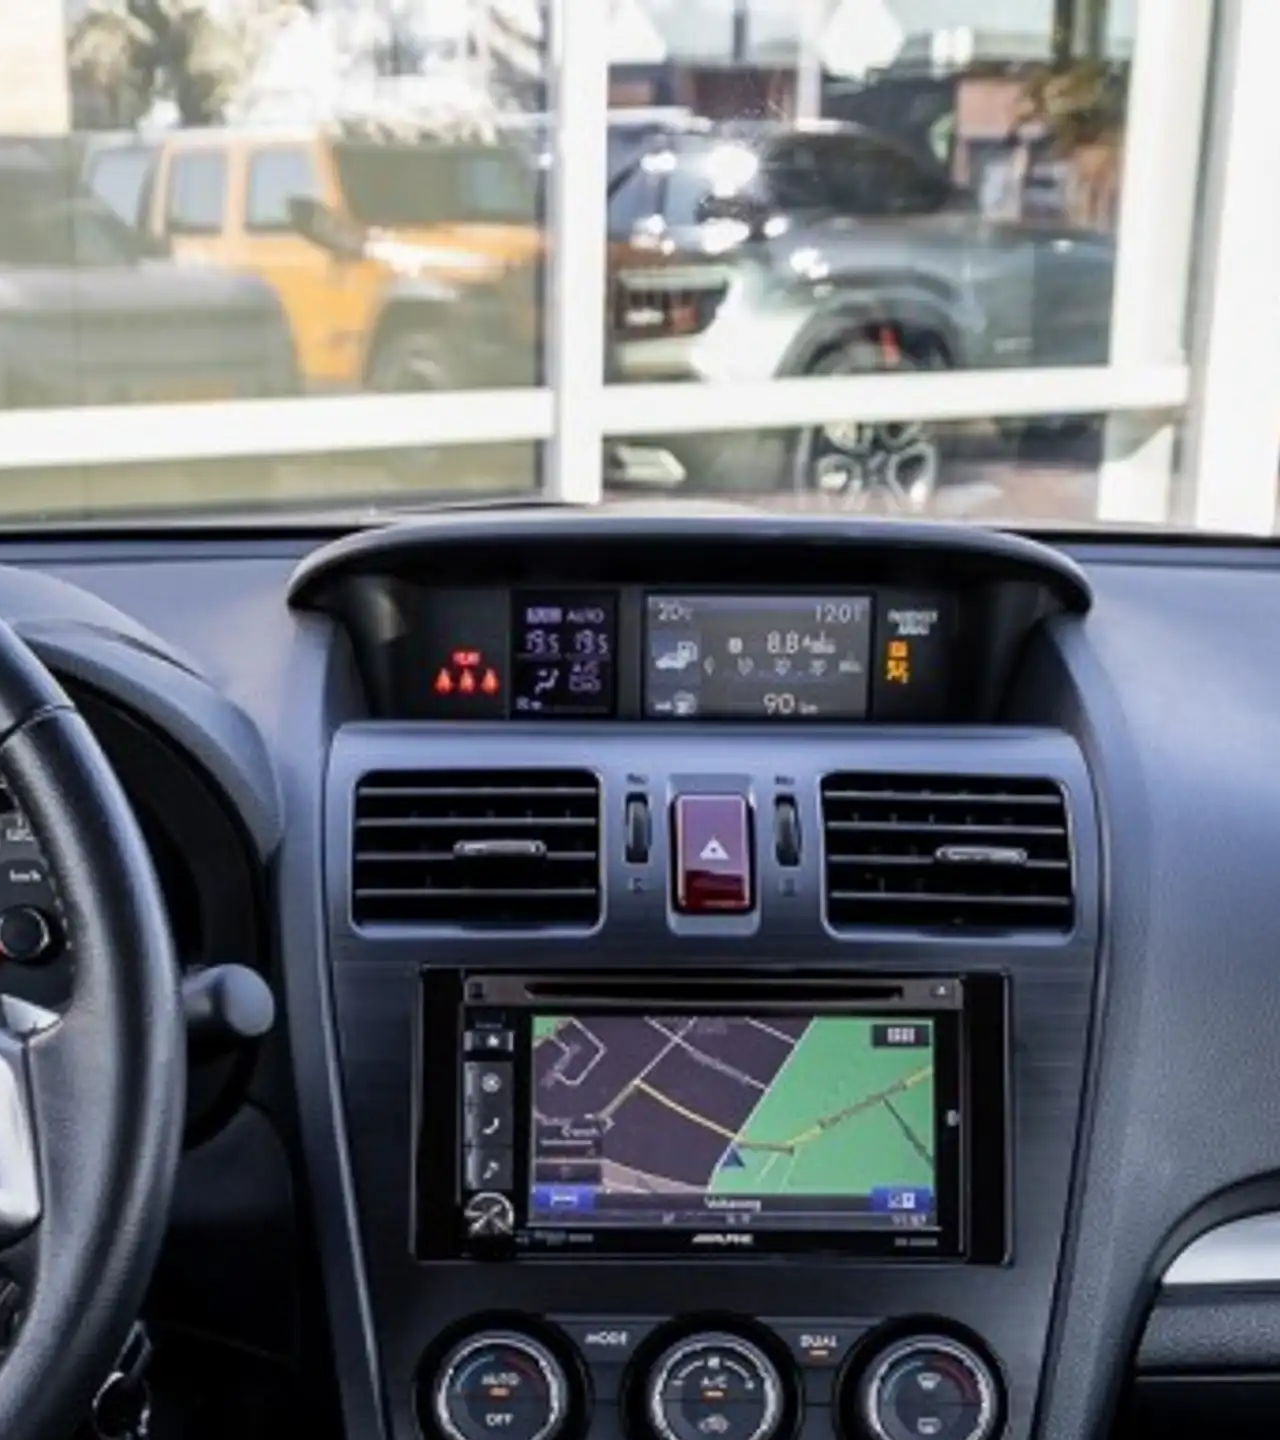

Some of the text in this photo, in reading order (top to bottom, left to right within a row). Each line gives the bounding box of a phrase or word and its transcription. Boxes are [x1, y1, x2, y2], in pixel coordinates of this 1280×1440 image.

[762, 692, 796, 715] 90
[584, 1331, 628, 1345] MODE
[485, 1413, 514, 1428] OFF
